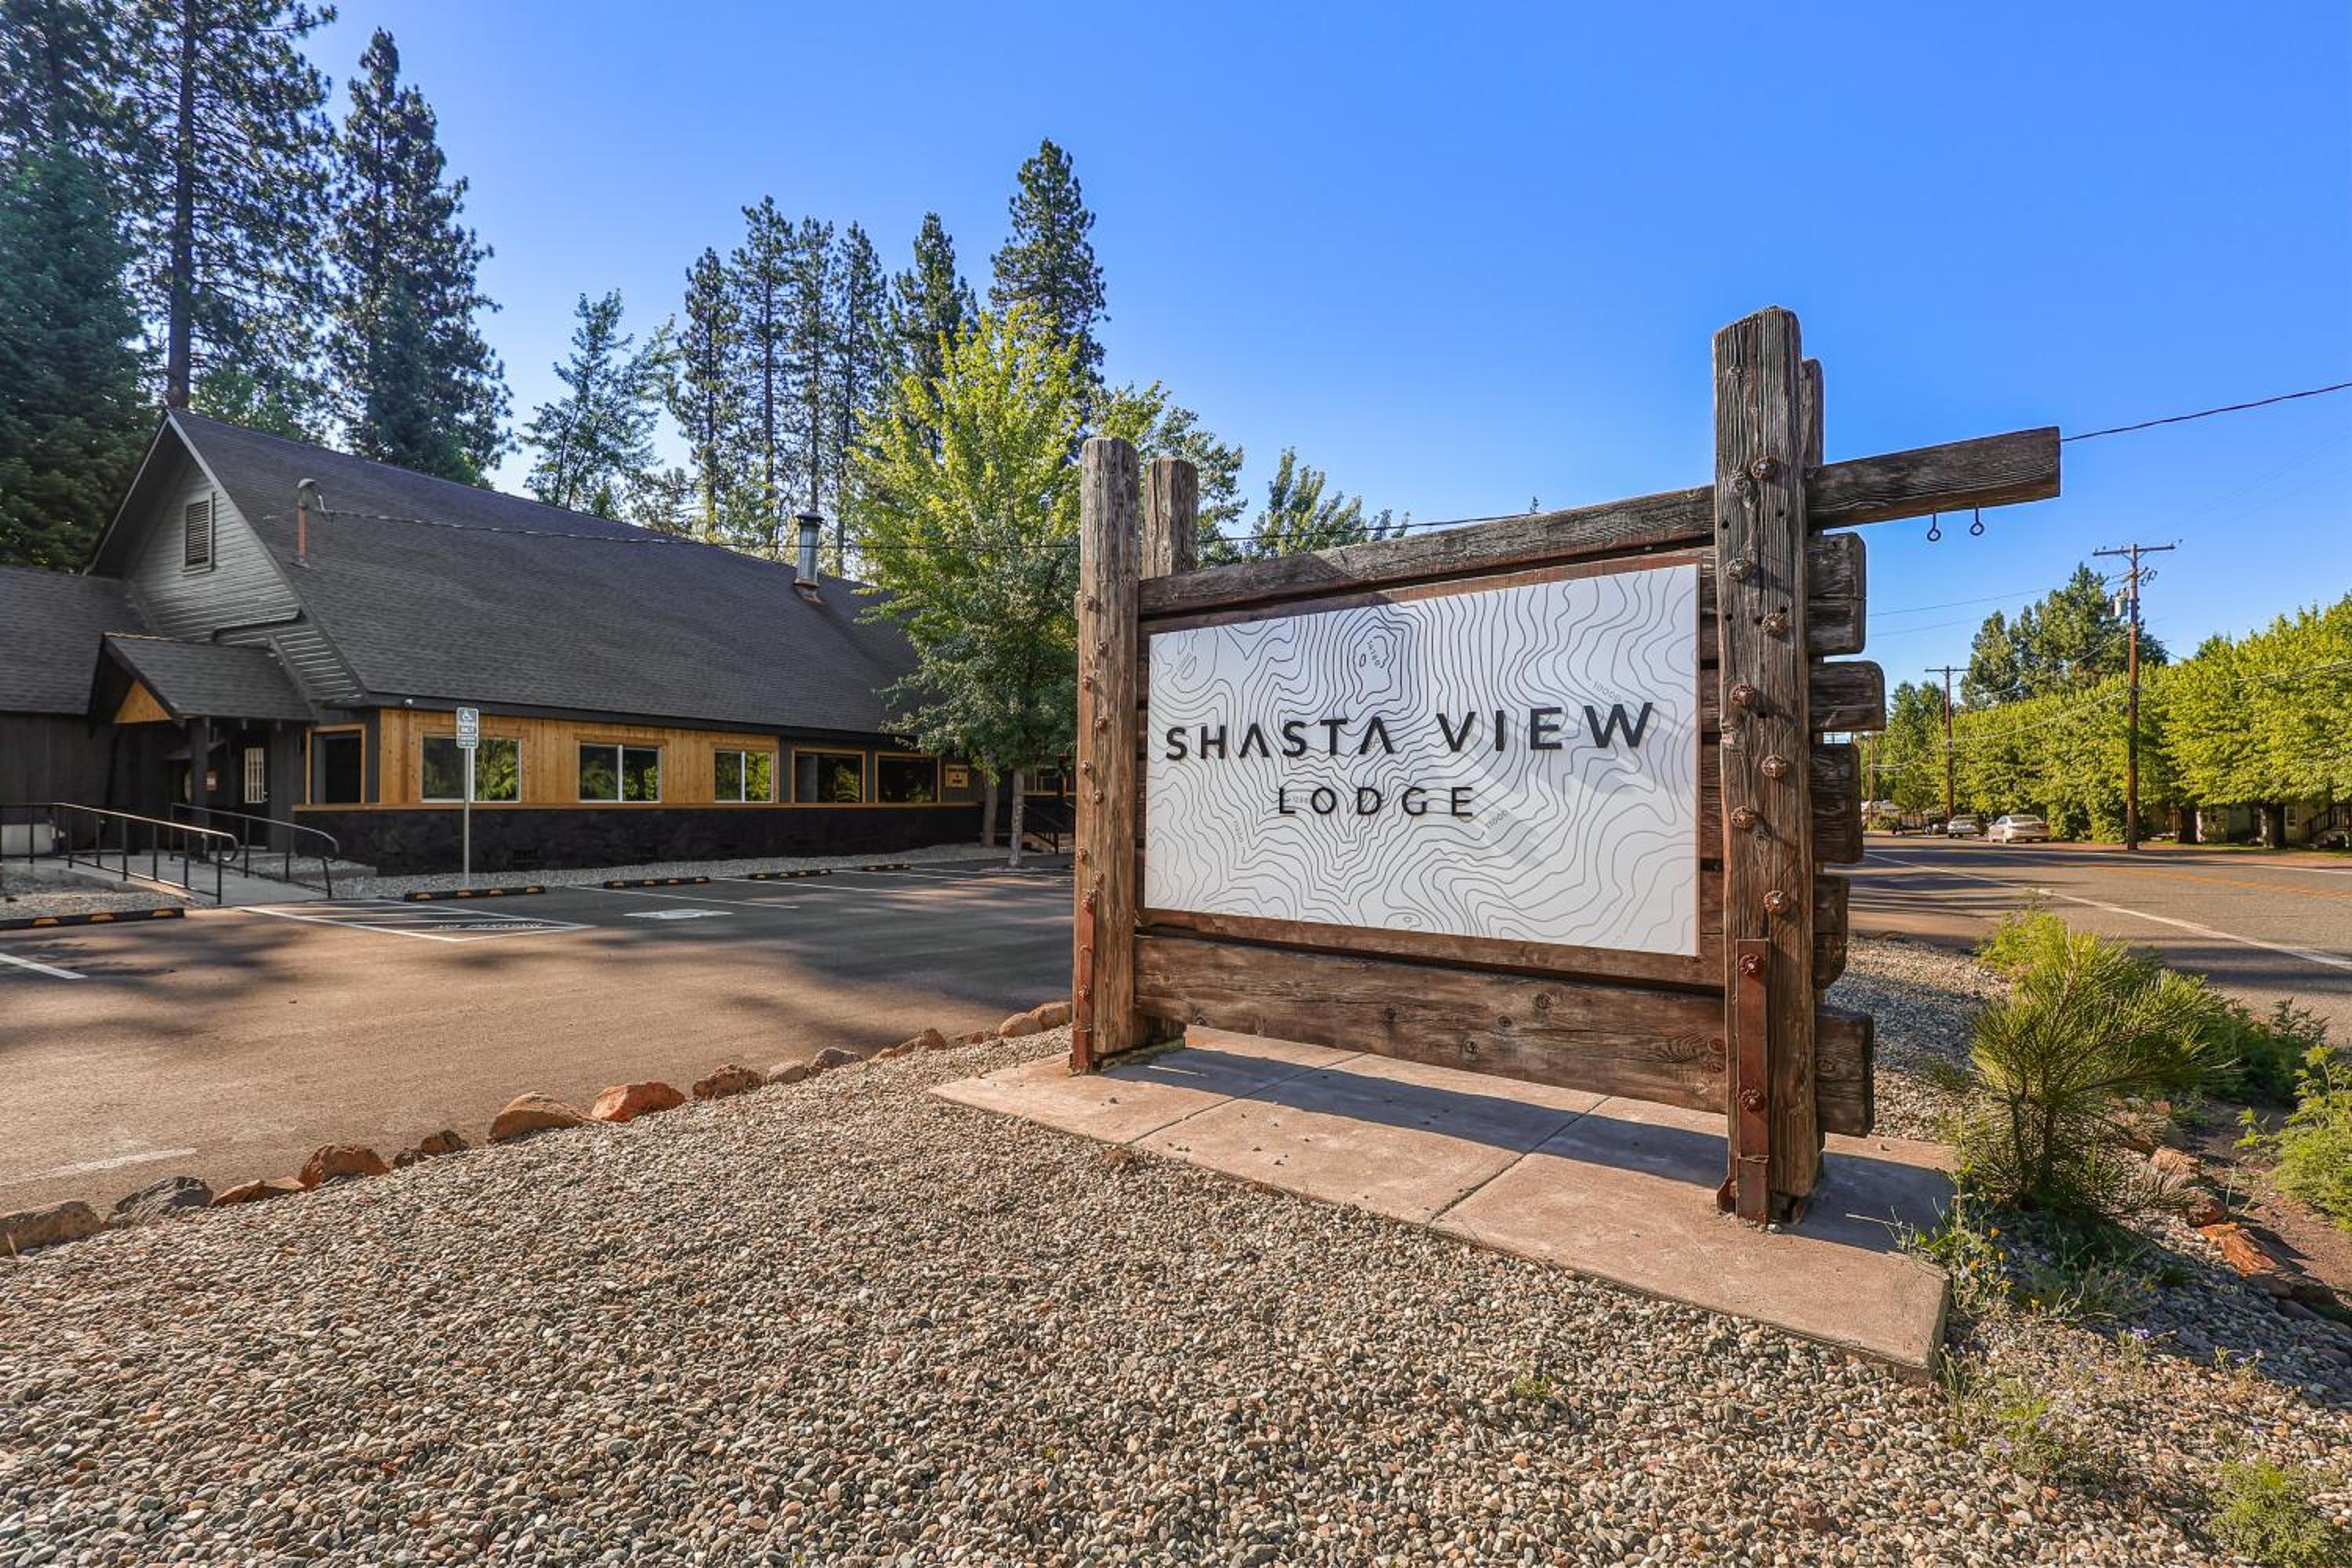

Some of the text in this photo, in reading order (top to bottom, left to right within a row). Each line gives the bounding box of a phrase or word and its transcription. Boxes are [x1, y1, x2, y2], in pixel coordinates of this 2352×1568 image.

[1166, 702, 1653, 760] SHASTA VIEW
[1279, 786, 1473, 817] LODGE
